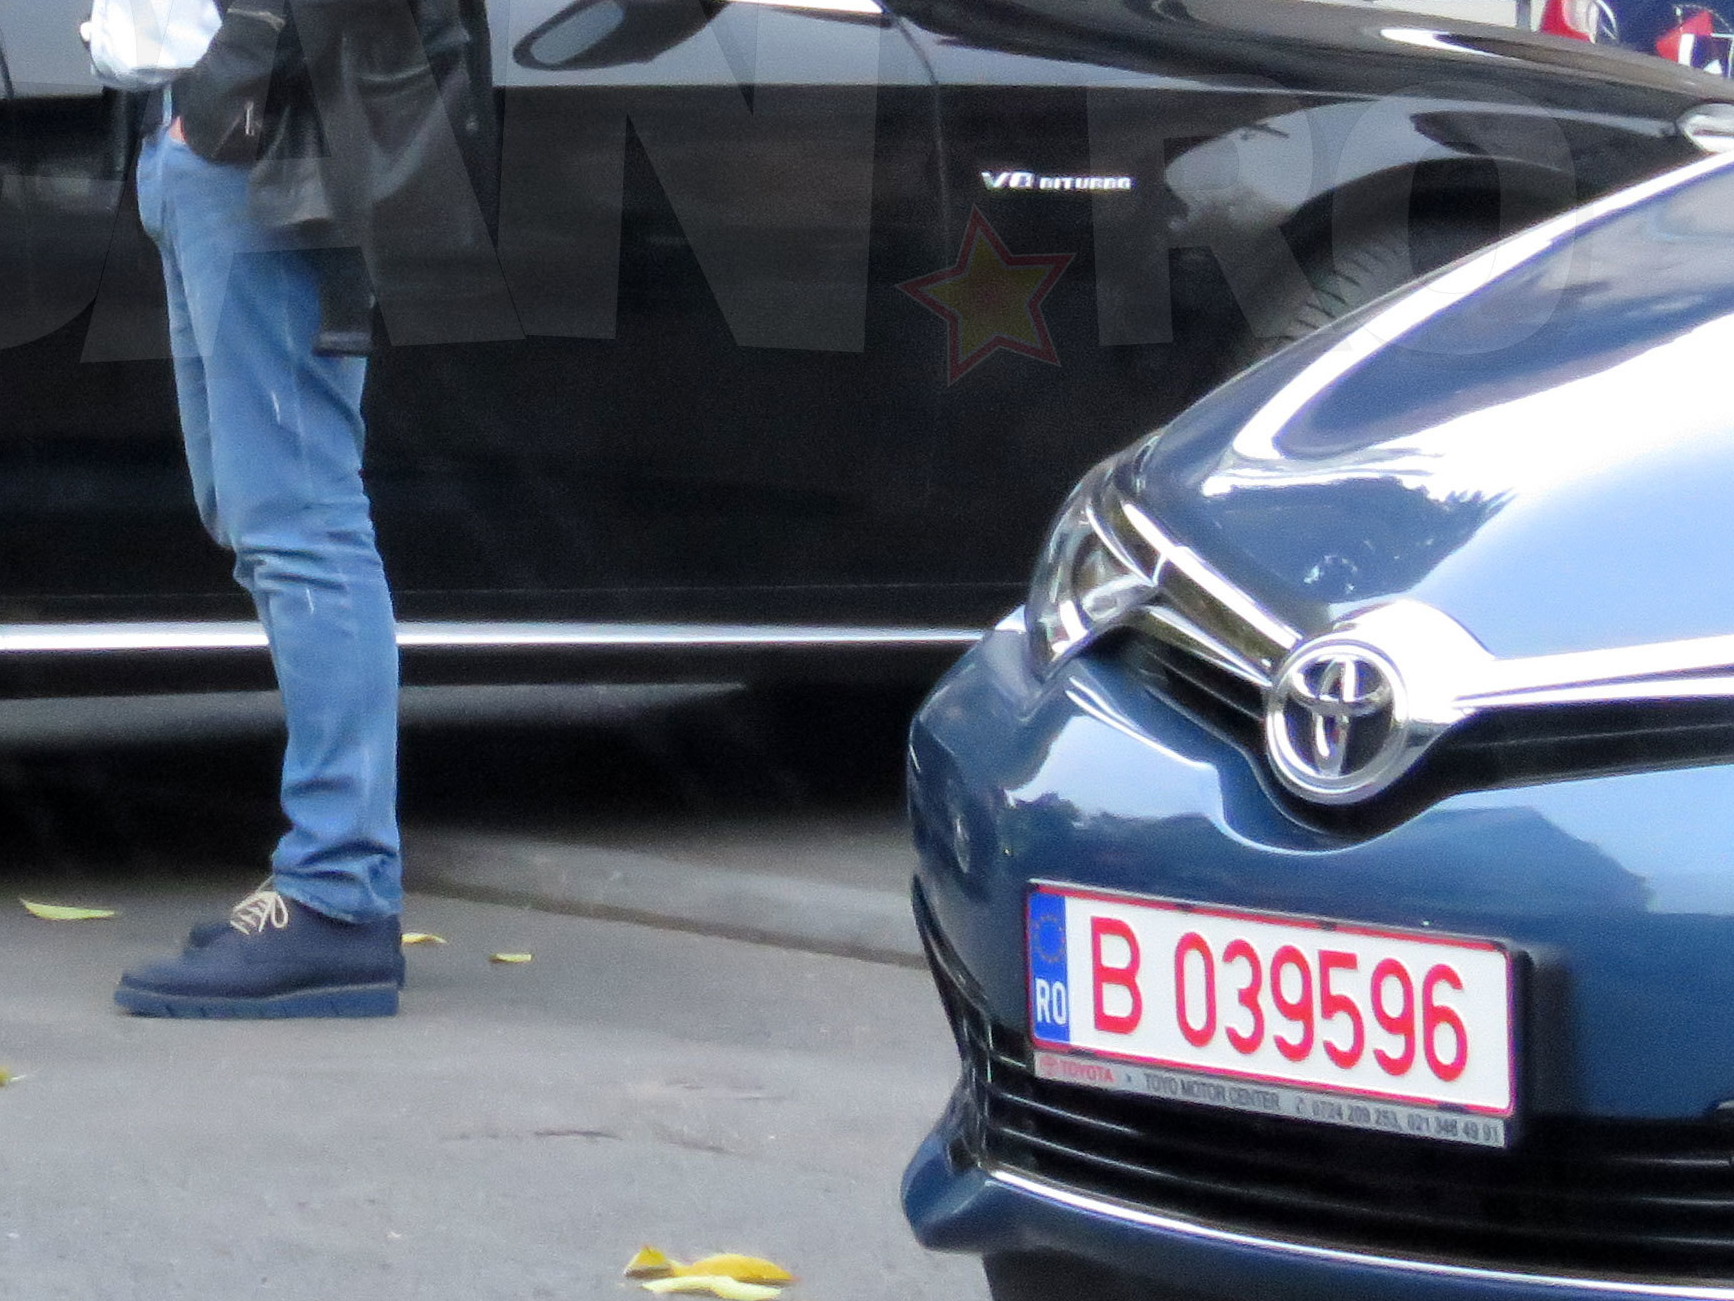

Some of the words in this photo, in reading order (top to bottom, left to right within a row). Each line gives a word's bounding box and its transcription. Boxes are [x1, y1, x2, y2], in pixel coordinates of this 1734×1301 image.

[1035, 977, 1067, 1026] RO
[1090, 916, 1143, 1034] B
[1174, 932, 1468, 1083] 039596
[1059, 1058, 1115, 1083] TOYOTA
[1145, 1072, 1178, 1096] TOYO
[1180, 1078, 1226, 1103] MOTOR
[1228, 1085, 1280, 1111] CENTER
